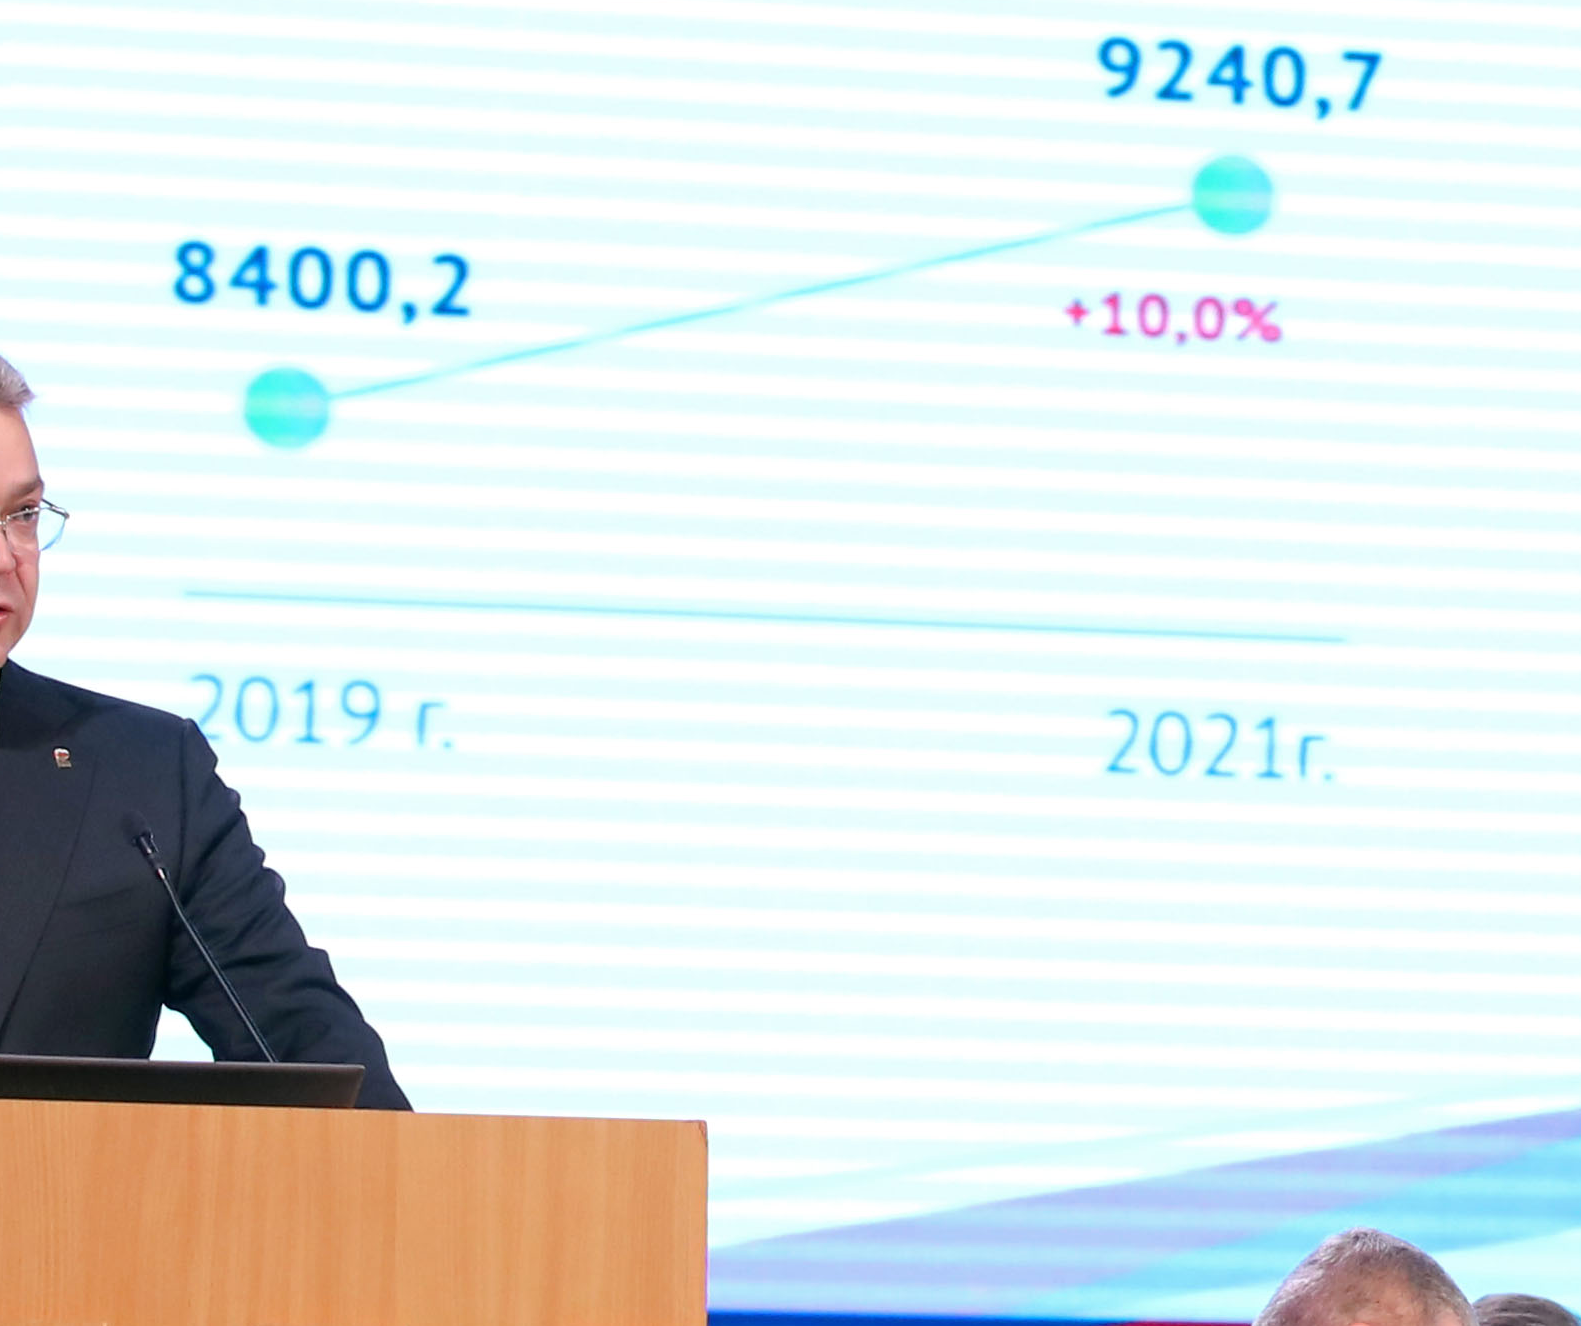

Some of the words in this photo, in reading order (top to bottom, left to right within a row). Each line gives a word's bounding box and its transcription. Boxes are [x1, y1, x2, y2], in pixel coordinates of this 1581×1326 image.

[1096, 37, 1384, 119] 9240,7
[172, 242, 472, 326] 8400,2
[1064, 293, 1284, 345] +10,0%
[189, 673, 380, 745] 2019
[417, 701, 452, 750] г.
